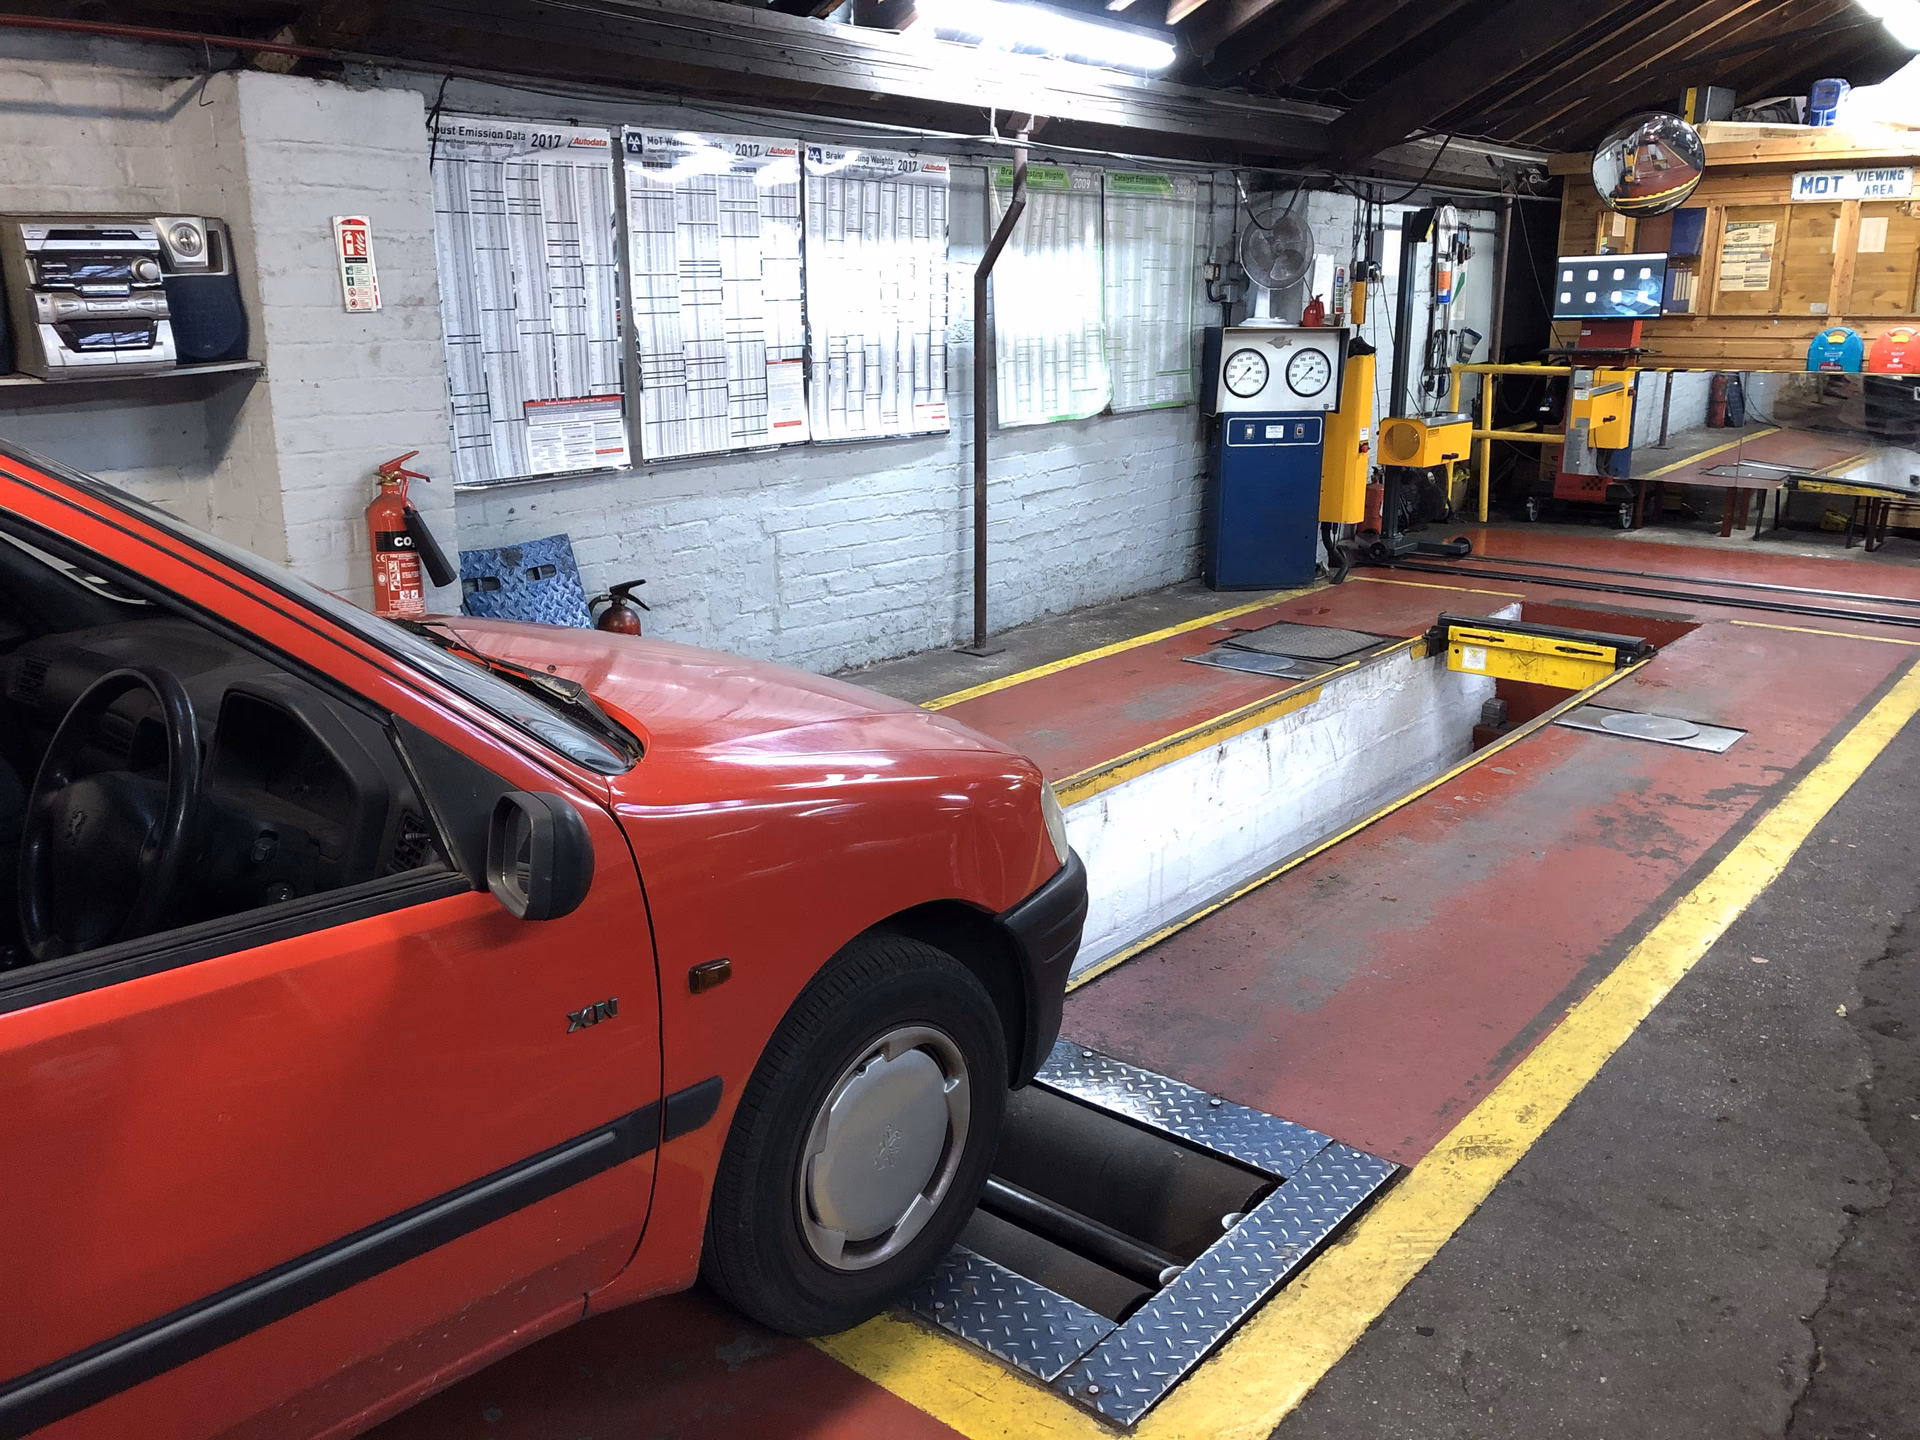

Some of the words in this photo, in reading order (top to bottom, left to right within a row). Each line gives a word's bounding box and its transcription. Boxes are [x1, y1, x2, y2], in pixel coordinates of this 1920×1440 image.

[458, 126, 504, 139] Emission
[506, 130, 526, 140] Data
[531, 133, 561, 148] 2017
[573, 137, 607, 147] Autodata
[647, 136, 663, 145] MoT
[735, 143, 760, 156] 2017
[769, 146, 796, 155] Autodata
[825, 151, 846, 160] Brake
[870, 155, 894, 166] Weights
[897, 159, 918, 172] 2017
[1000, 166, 1014, 176] Bra
[1026, 170, 1043, 179] esting
[1044, 171, 1064, 180] Weights
[1856, 169, 1905, 182] VIEWING
[1073, 178, 1091, 189] 2009
[1176, 185, 1190, 195] 2009
[1799, 175, 1844, 194] MOT
[1863, 184, 1894, 196] AREA
[567, 997, 618, 1034] XN
